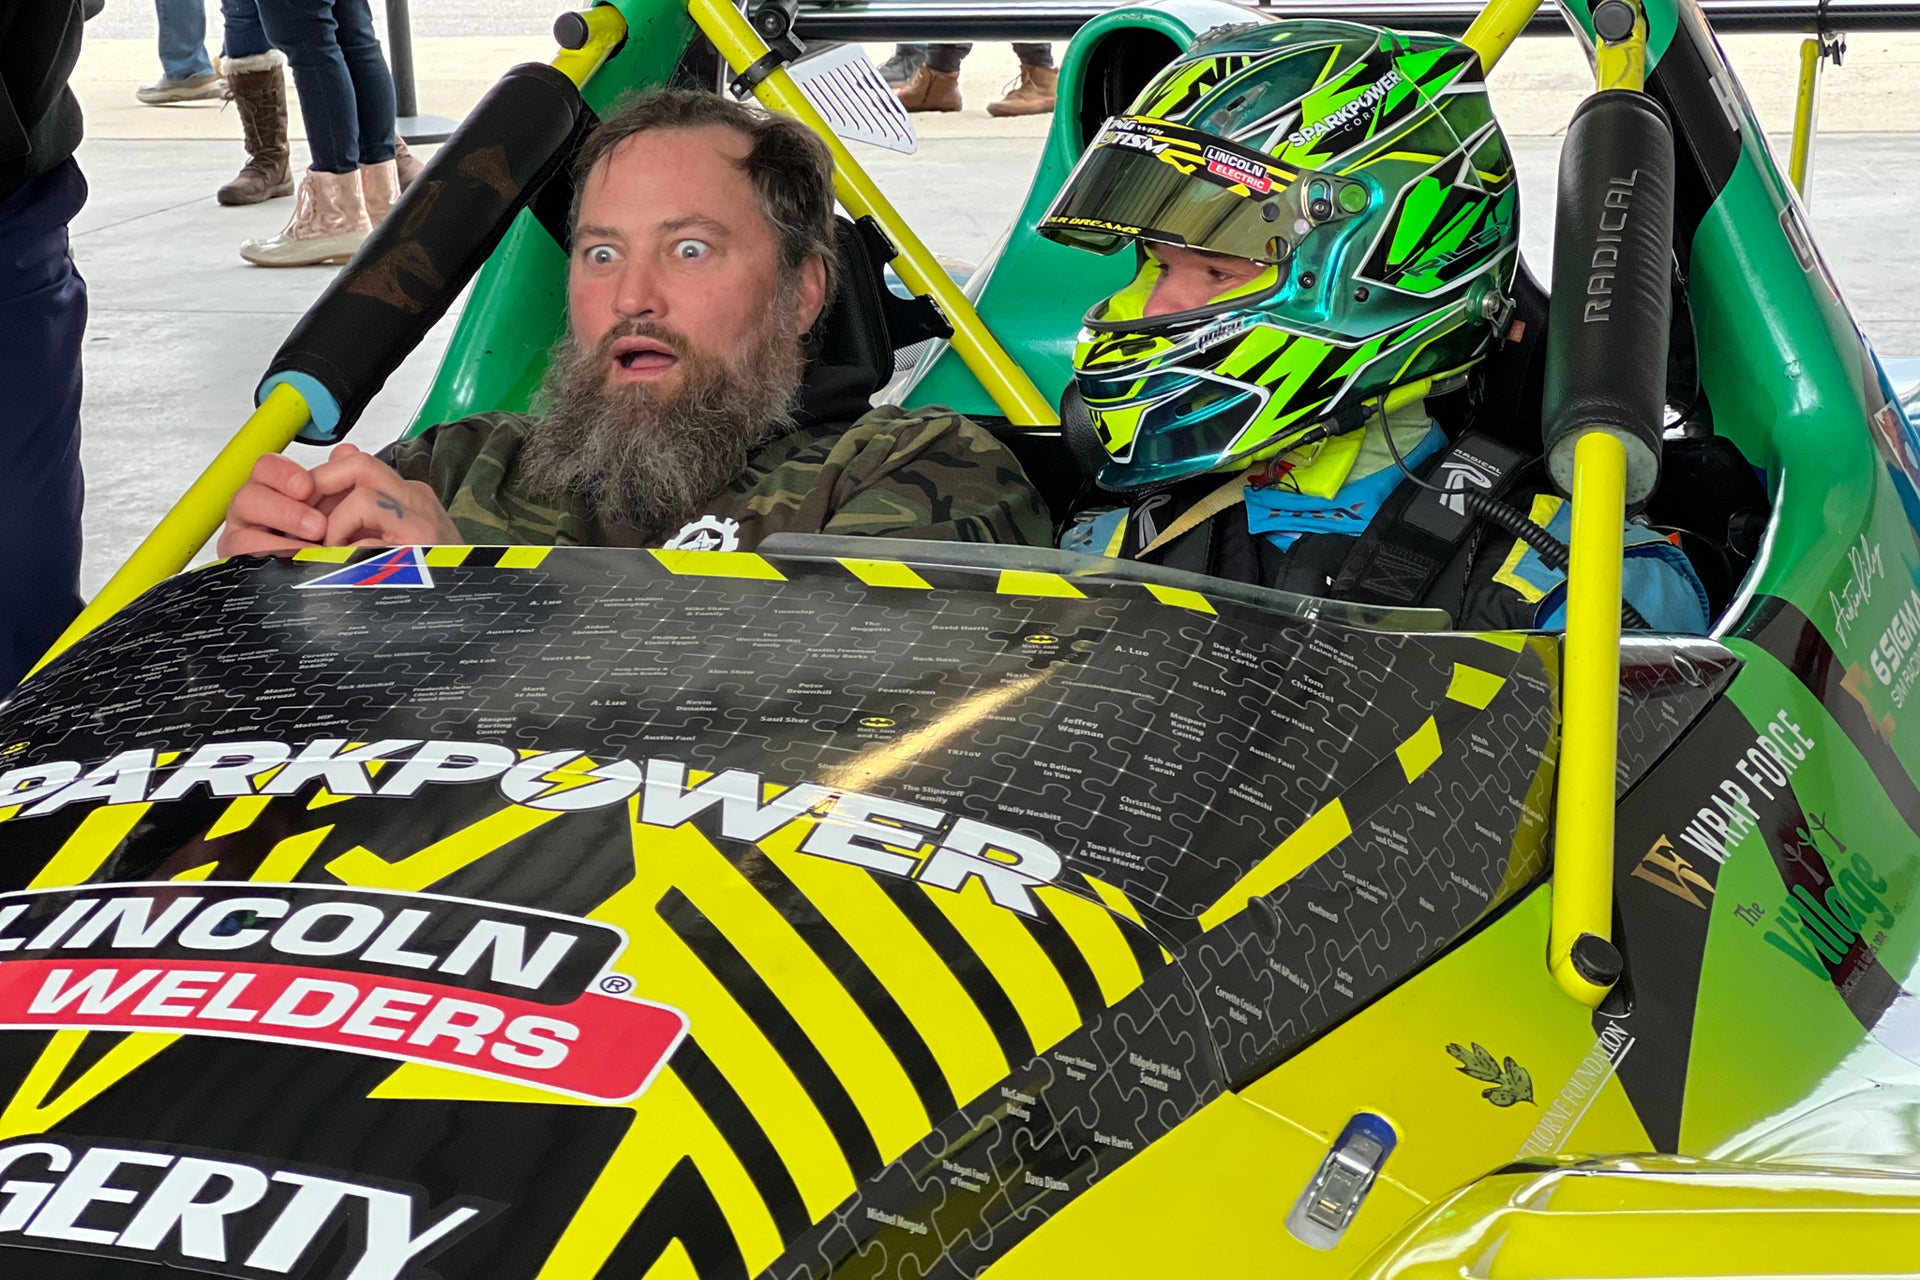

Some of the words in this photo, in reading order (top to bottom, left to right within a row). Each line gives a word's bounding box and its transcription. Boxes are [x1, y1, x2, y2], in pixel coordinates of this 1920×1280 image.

[1288, 70, 1402, 147] SPARKPOWER
[1206, 149, 1264, 178] LINCOLN
[1214, 164, 1265, 189] ELECTRIC
[1068, 218, 1141, 235] DREAMS
[1584, 169, 1638, 323] RADICAL
[1454, 449, 1502, 475] RADICAL
[1114, 645, 1127, 653] A.
[1234, 647, 1258, 661] Kelly
[1211, 650, 1229, 660] and
[1230, 653, 1260, 670] Carter
[1192, 681, 1209, 692] Ken
[1210, 685, 1227, 697] Loh
[1303, 674, 1325, 689] Tom
[1062, 716, 1099, 730] Jeffrey
[1170, 712, 1207, 729] Mosport
[1171, 720, 1205, 737] Karting
[1271, 709, 1290, 724] Gary
[1291, 717, 1315, 733] Hajek
[1057, 724, 1104, 739] Wagman
[1172, 728, 1201, 742] Centre
[1033, 760, 1048, 769] We
[1049, 763, 1083, 775] Believe
[1143, 753, 1164, 767] Josh
[1165, 759, 1183, 771] and
[1249, 746, 1274, 762] Austin
[1276, 756, 1296, 771] Fan!
[1043, 769, 1052, 777] In
[1053, 771, 1072, 780] You
[1149, 764, 1176, 777] Sarah
[902, 784, 923, 793] The
[925, 785, 965, 798] Slipacoff
[1239, 783, 1264, 798] Aidan
[1679, 779, 1757, 865] WRAP
[1735, 708, 1816, 806] FORCE
[915, 793, 948, 805] Family
[1120, 795, 1162, 812] Christian
[1228, 787, 1273, 812] Shimbashi
[997, 804, 1025, 818] Wally
[1026, 808, 1062, 822] Nesbitt
[1118, 804, 1162, 822] Stephens
[1086, 840, 1106, 853] Tom
[1107, 847, 1142, 861] Harder
[1079, 849, 1088, 857] &
[1089, 851, 1111, 865] Kass
[1112, 857, 1146, 872] Harder
[1733, 901, 1766, 927] The
[1762, 852, 1895, 981] Village
[0, 897, 577, 989] LINCOLN
[1215, 985, 1240, 1007] Corvette
[1240, 998, 1263, 1020] Cruising
[28, 968, 579, 1070] WELDERS
[1229, 1007, 1248, 1025] Rebels
[1129, 1052, 1161, 1076] Ridgeley
[1161, 1063, 1182, 1081] Welsh
[1560, 1020, 1630, 1107] FOUNDATION
[1140, 1072, 1168, 1092] Sonoma
[1006, 1102, 1030, 1122] Racing
[1094, 1131, 1111, 1145] Dave
[1112, 1135, 1134, 1150] Harris
[942, 1160, 953, 1172] The
[1025, 1171, 1044, 1187] Dava
[1045, 1177, 1070, 1192] Dixon
[0, 1143, 480, 1280] GERTY
[866, 1207, 897, 1226] Michael
